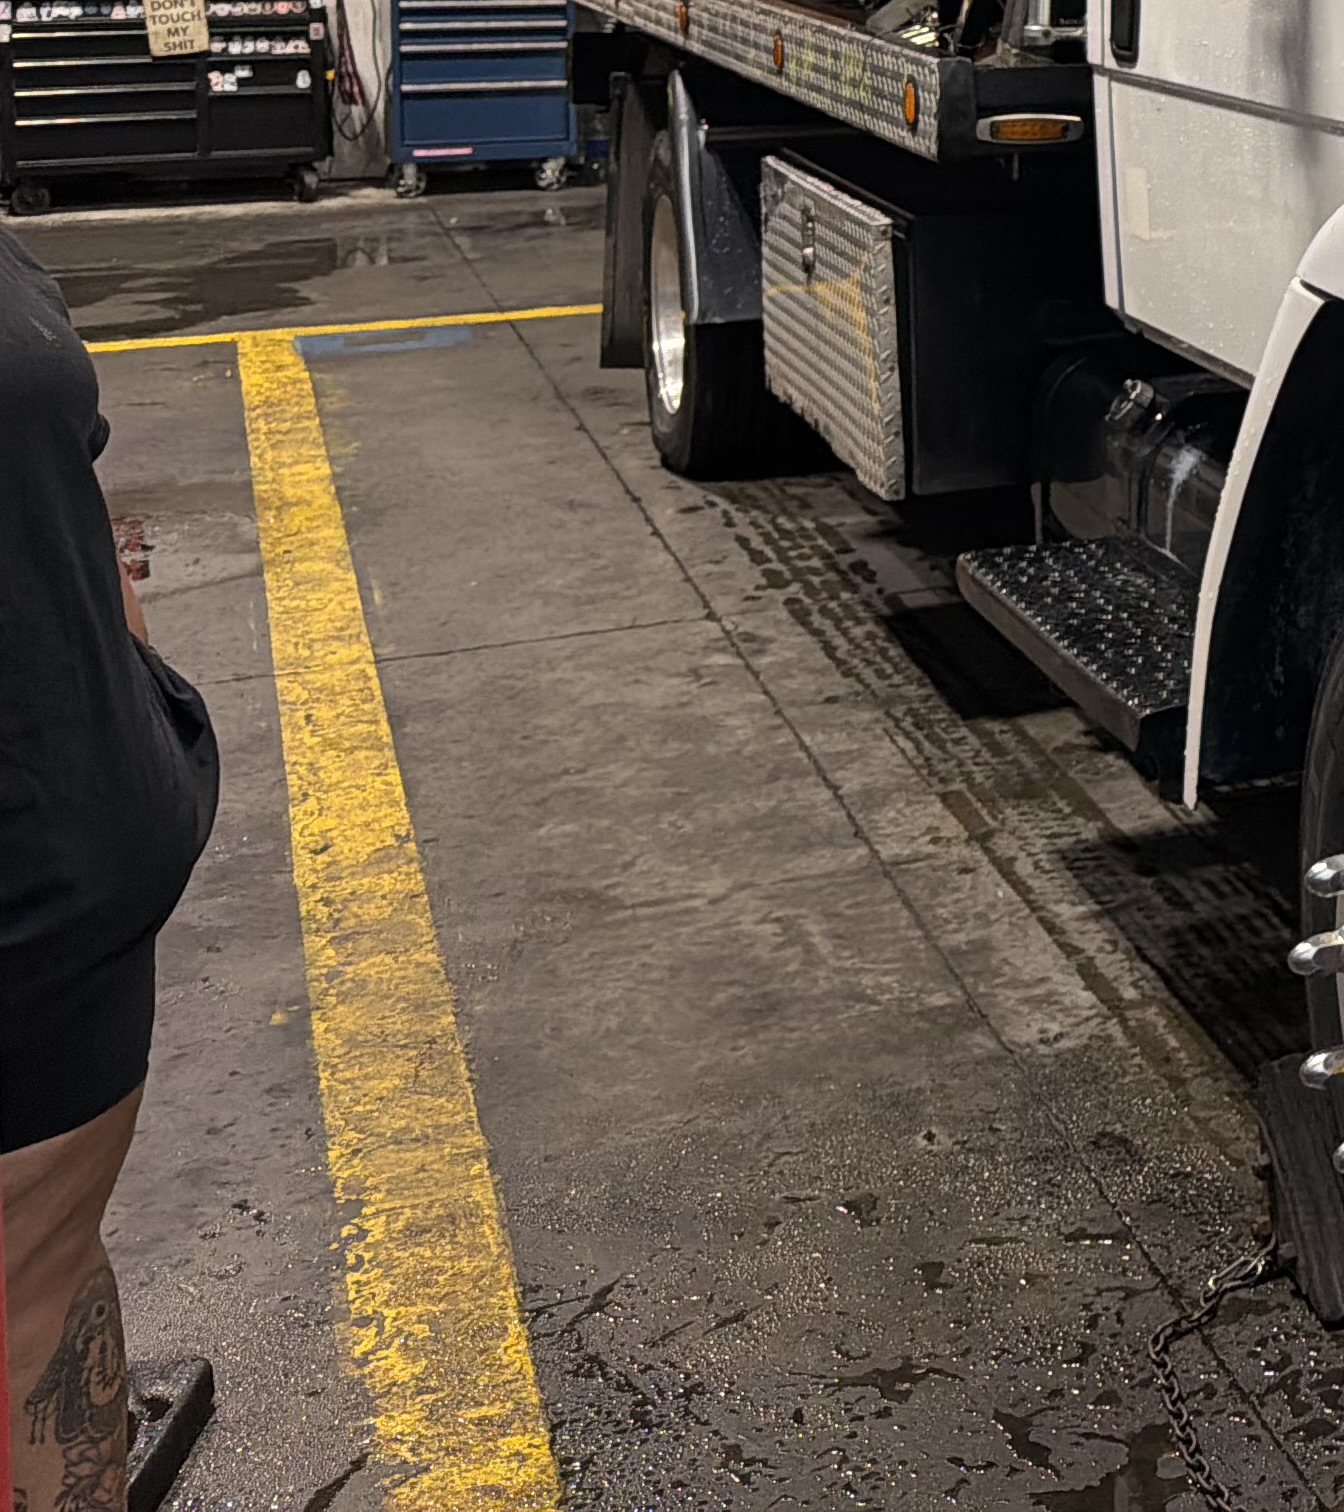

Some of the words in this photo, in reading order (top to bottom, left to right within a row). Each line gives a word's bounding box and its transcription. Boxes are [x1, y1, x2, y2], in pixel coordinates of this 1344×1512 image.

[150, 9, 201, 26] TOUCH
[166, 25, 190, 38] MY
[163, 39, 195, 52] SHIT
